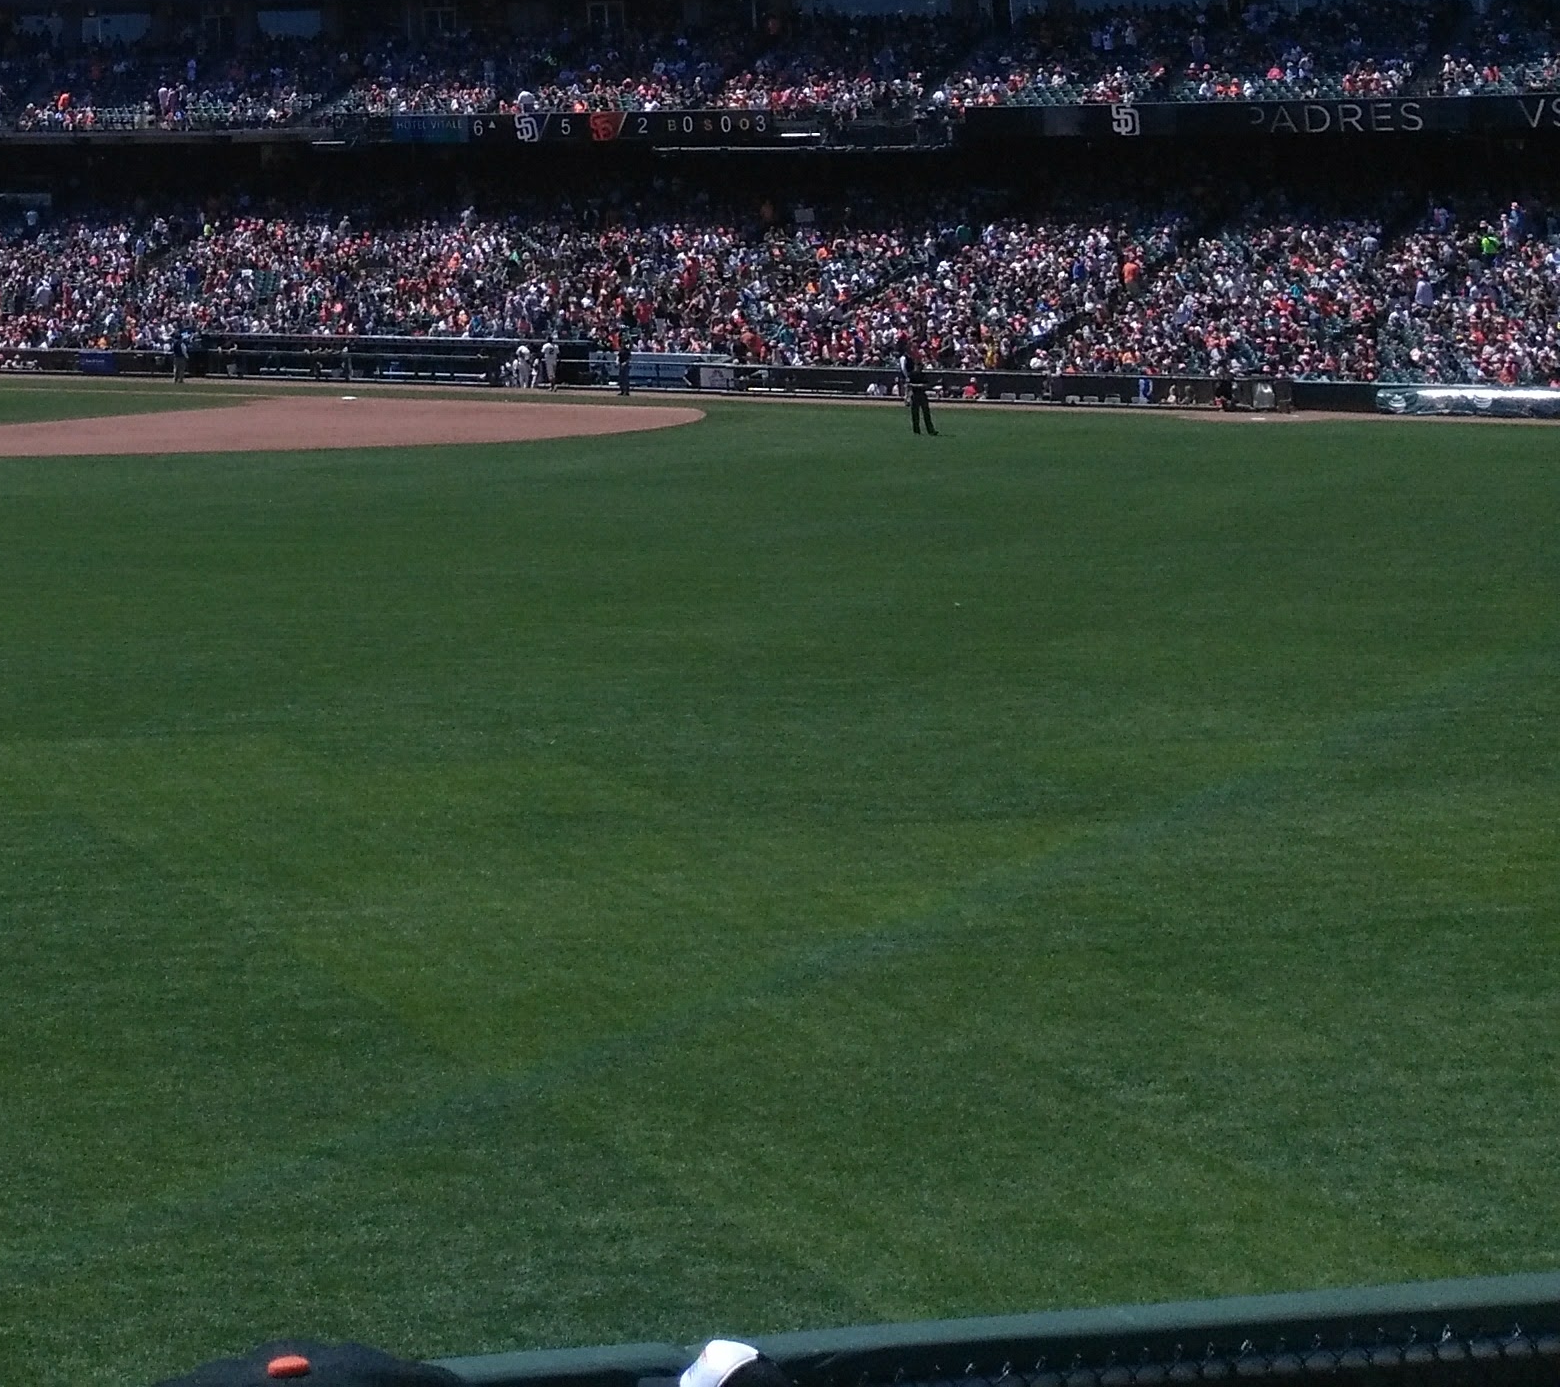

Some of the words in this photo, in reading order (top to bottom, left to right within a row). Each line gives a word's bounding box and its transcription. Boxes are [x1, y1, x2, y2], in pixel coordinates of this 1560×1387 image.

[396, 120, 426, 130] HOTEL
[473, 119, 483, 137] 6
[561, 118, 571, 135] 5
[637, 117, 648, 134] 2
[668, 119, 676, 131] B
[682, 116, 693, 133] 0
[703, 118, 713, 131] S
[720, 115, 732, 133] 0
[755, 114, 766, 132] 3
[1249, 102, 1424, 133] PADRES
